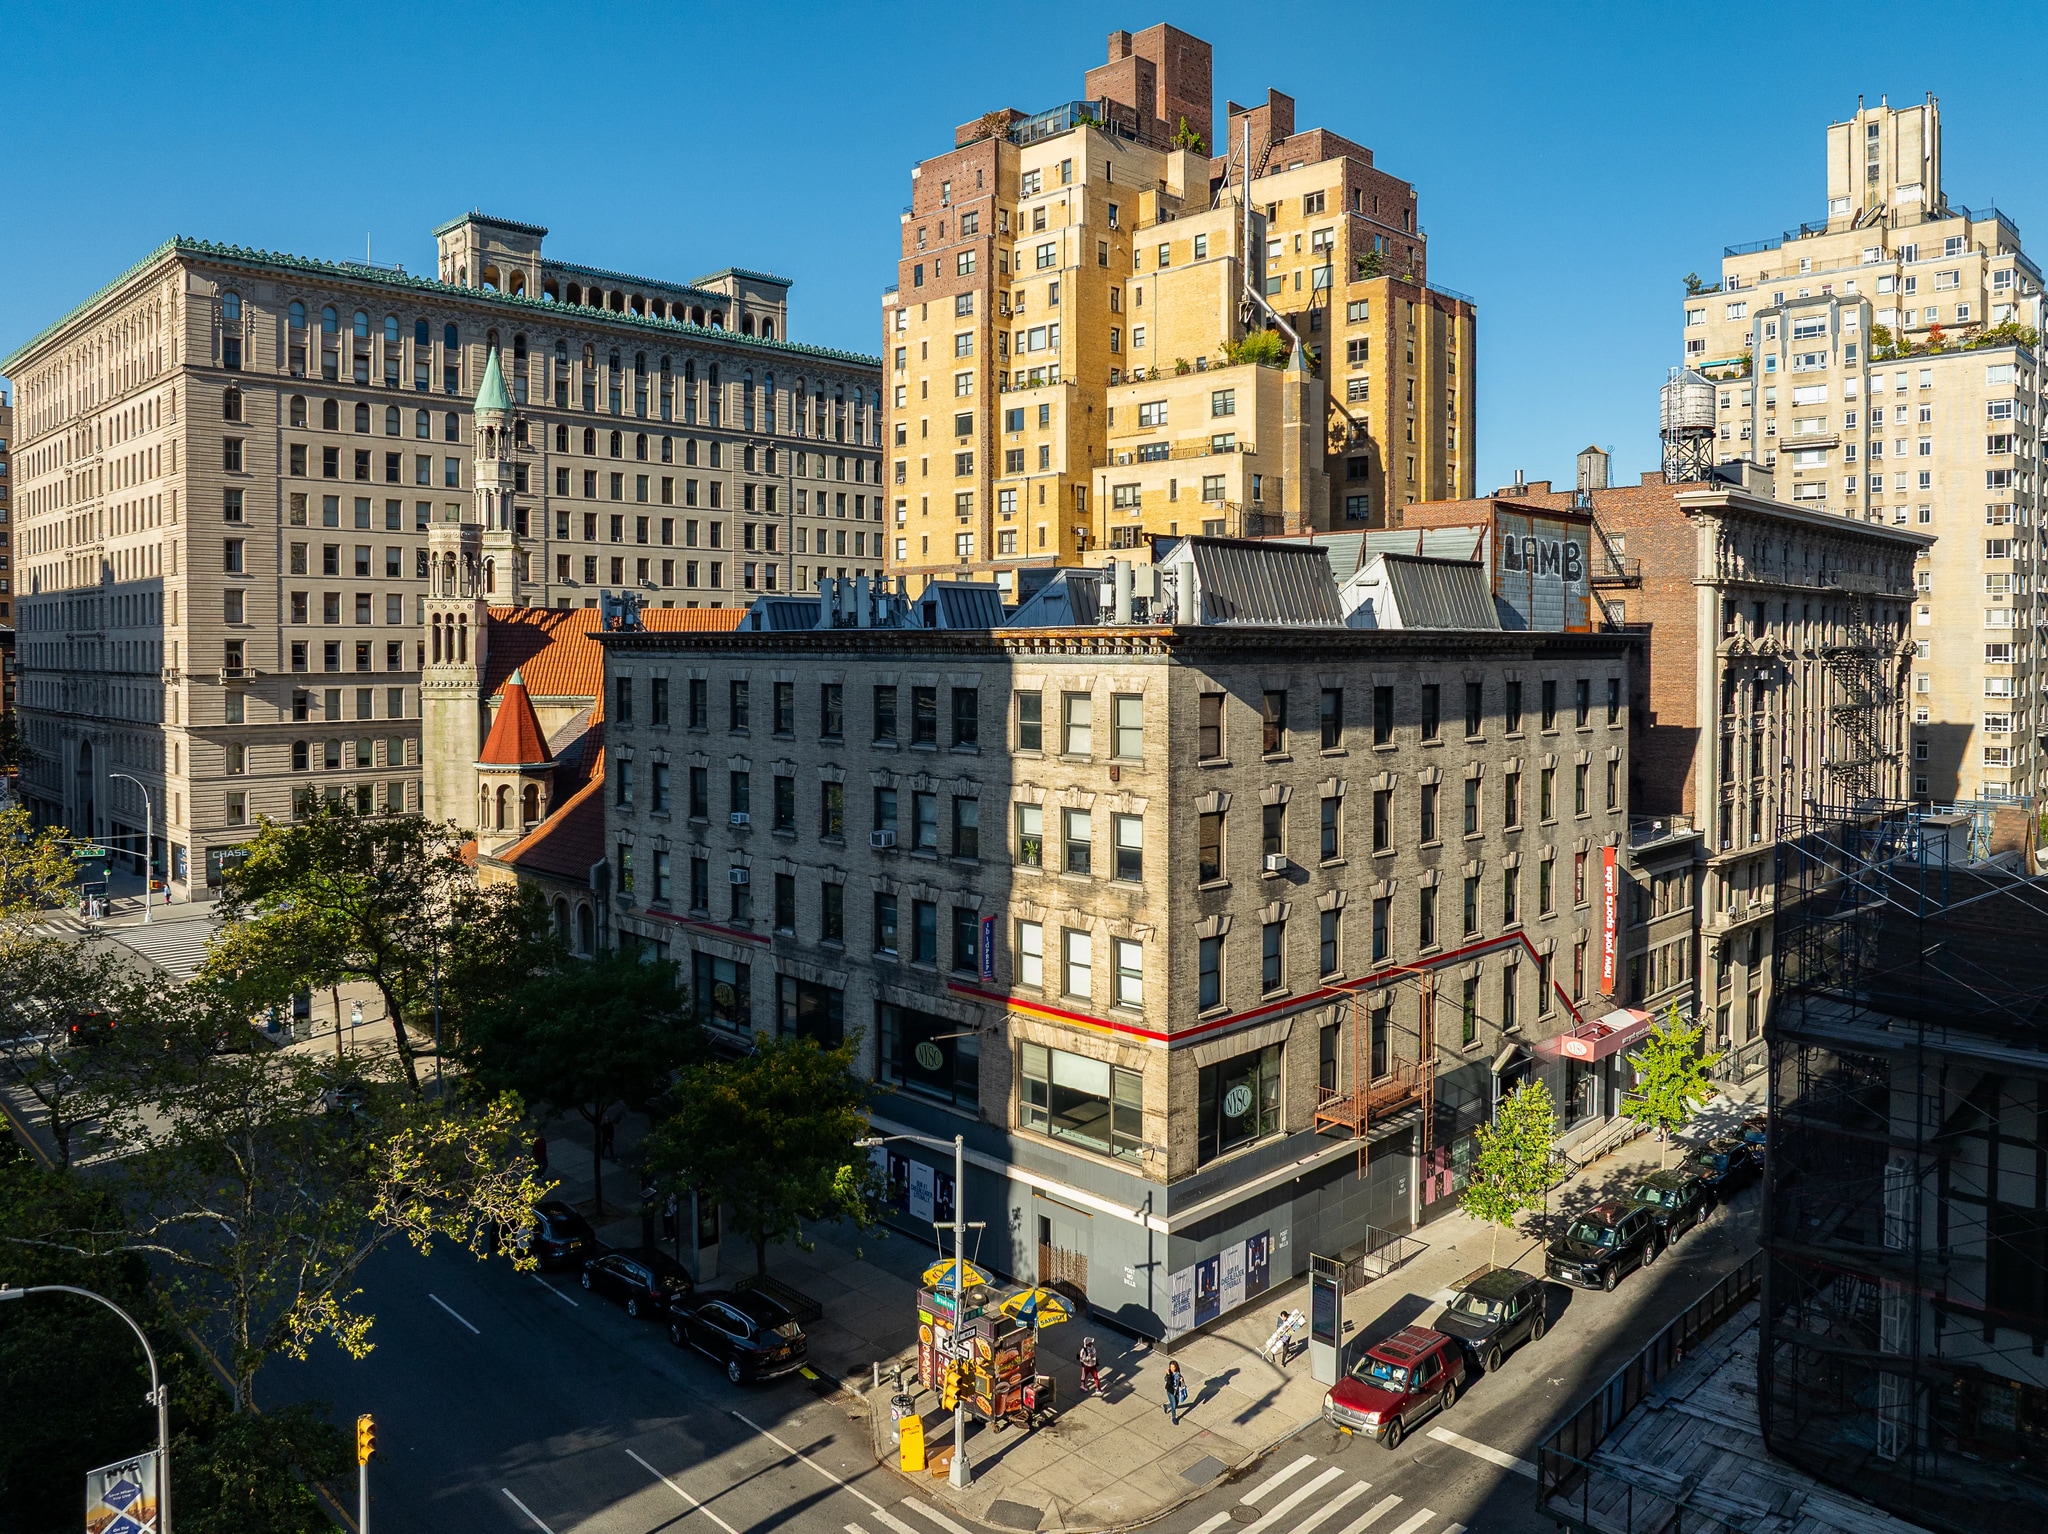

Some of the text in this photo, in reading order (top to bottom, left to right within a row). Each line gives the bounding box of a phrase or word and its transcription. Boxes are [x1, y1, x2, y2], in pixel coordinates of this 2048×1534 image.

[1503, 534, 1583, 583] LAMB
[213, 849, 248, 859] CHASE
[1606, 895, 1615, 928] sports
[1604, 931, 1614, 954] york
[918, 1045, 940, 1067] NYSC
[1227, 1089, 1248, 1114] NYSC
[107, 1463, 139, 1478] NYC
